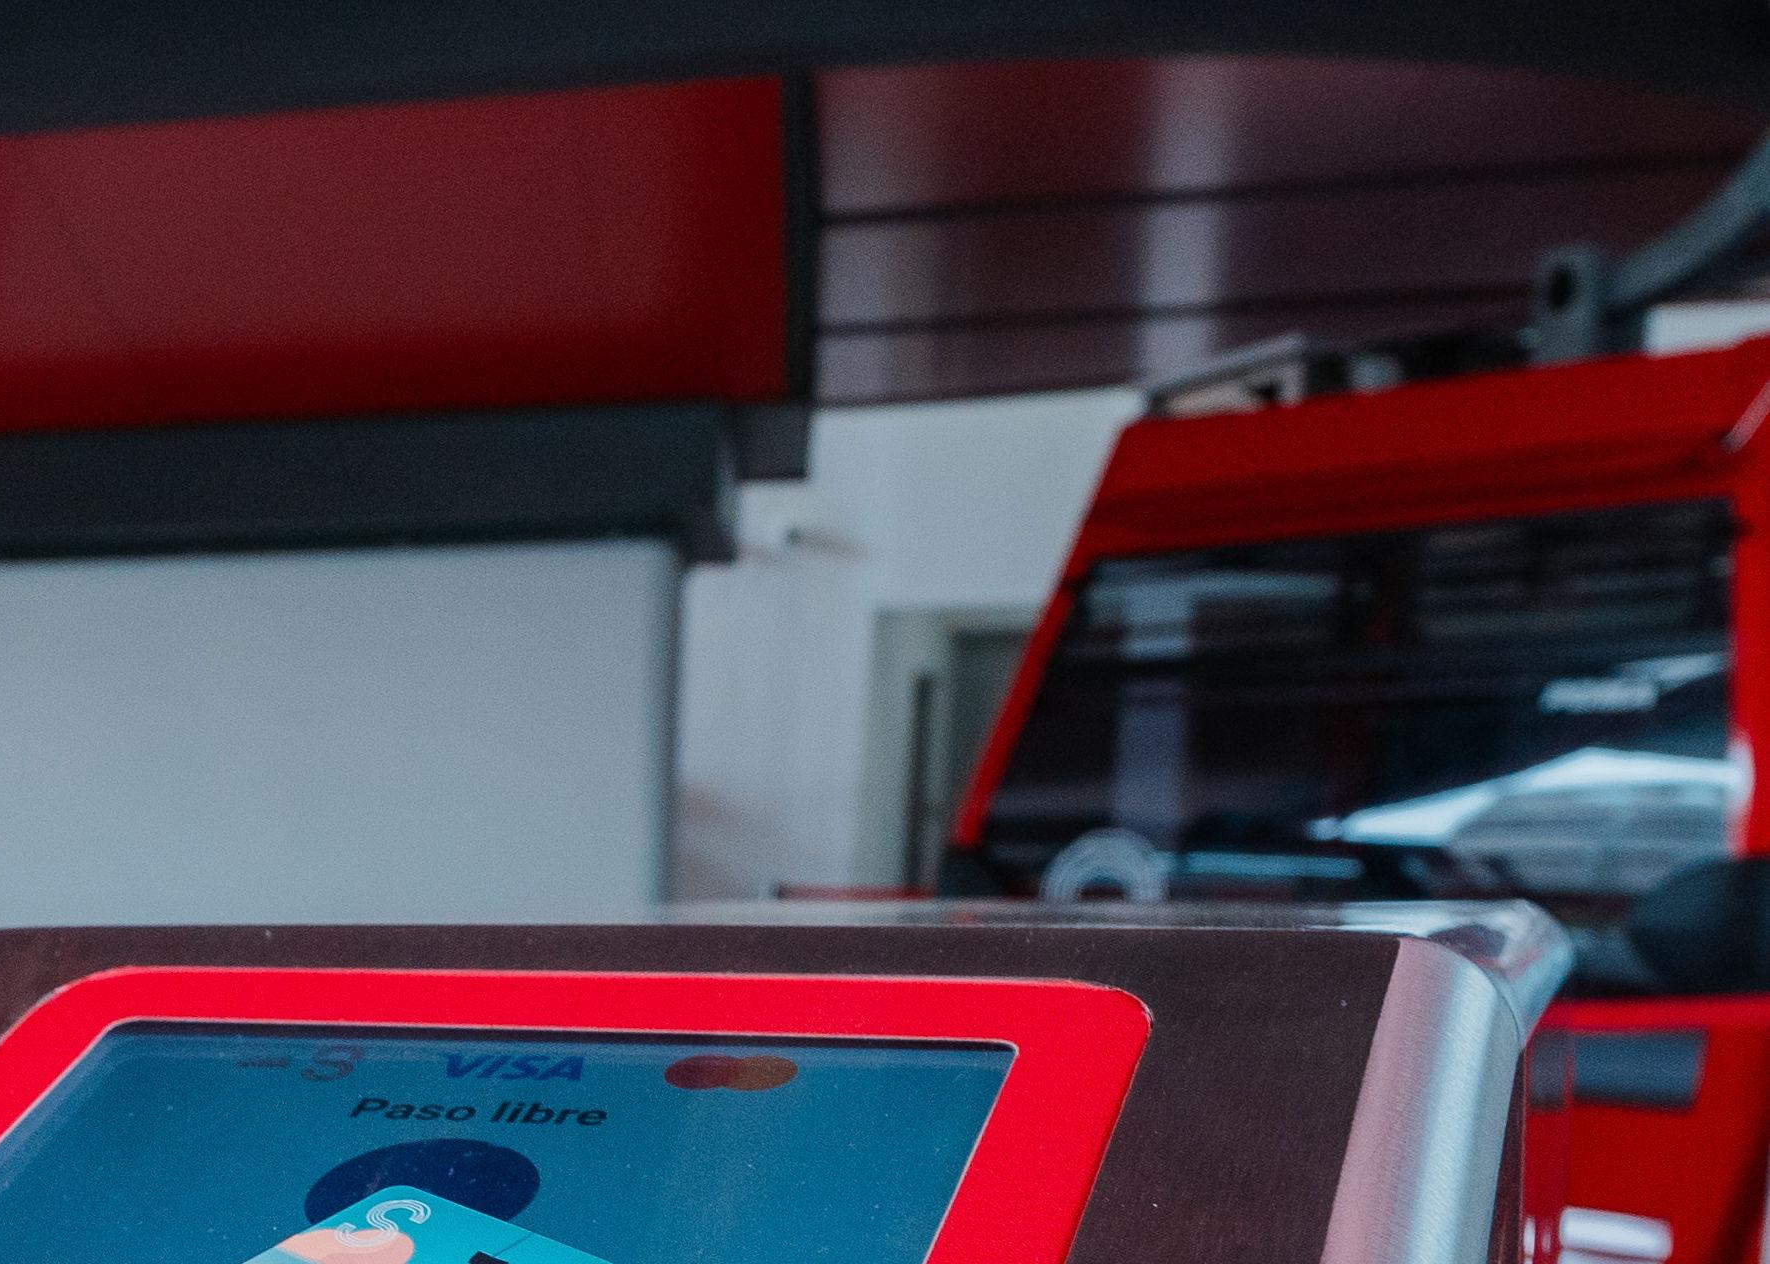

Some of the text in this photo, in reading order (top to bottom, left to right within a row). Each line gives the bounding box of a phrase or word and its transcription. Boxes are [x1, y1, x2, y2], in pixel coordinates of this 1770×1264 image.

[445, 1054, 583, 1081] VISA
[349, 1098, 608, 1126] Paso libre
